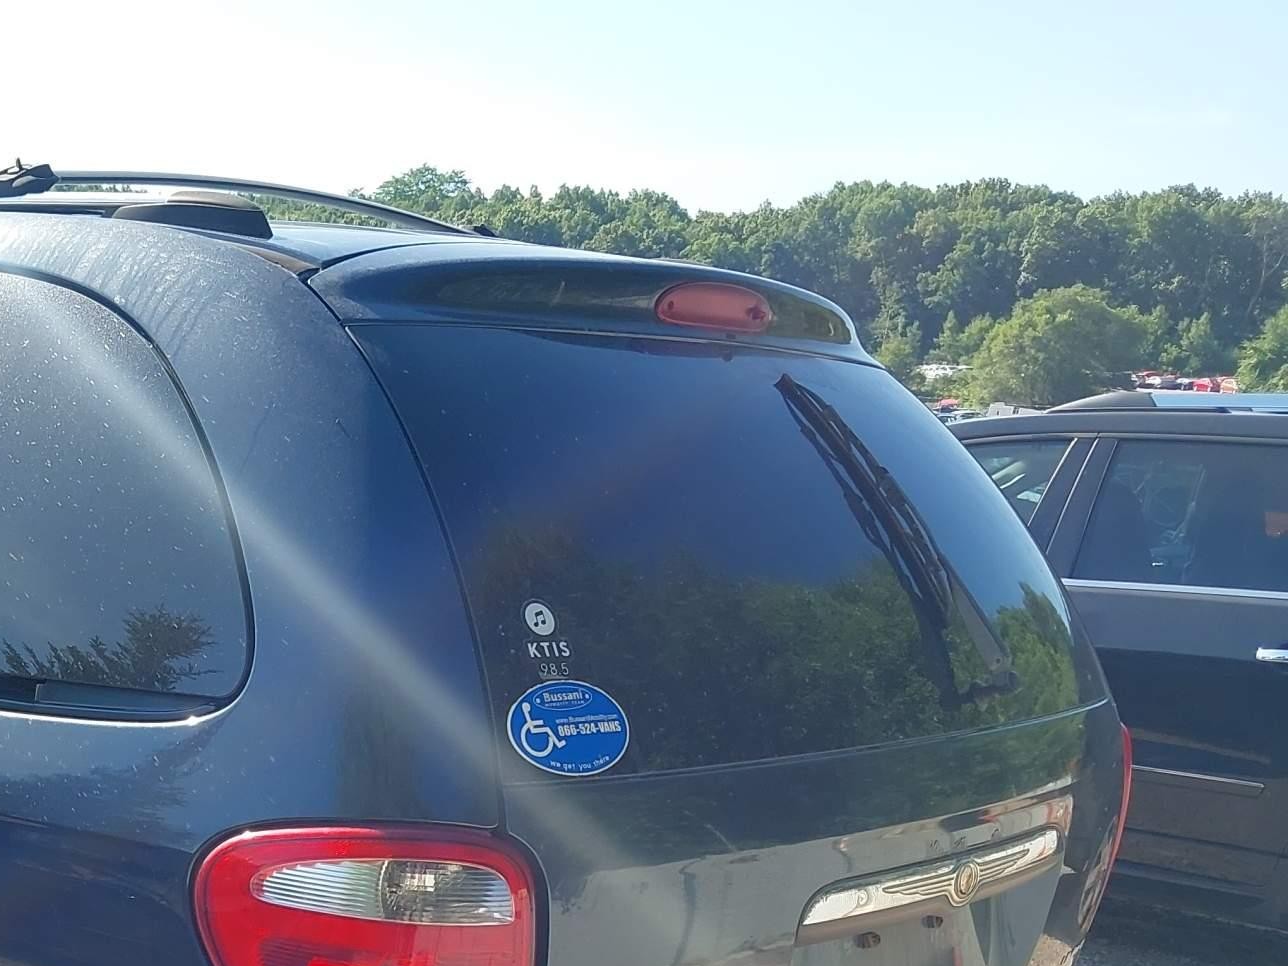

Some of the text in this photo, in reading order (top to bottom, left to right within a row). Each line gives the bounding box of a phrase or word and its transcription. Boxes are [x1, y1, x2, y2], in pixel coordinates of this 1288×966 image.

[527, 641, 570, 658] KTIS
[540, 662, 569, 676] 98.5
[542, 689, 583, 702] Bussani
[557, 720, 622, 737] 866-524-VANS
[579, 763, 592, 771] you
